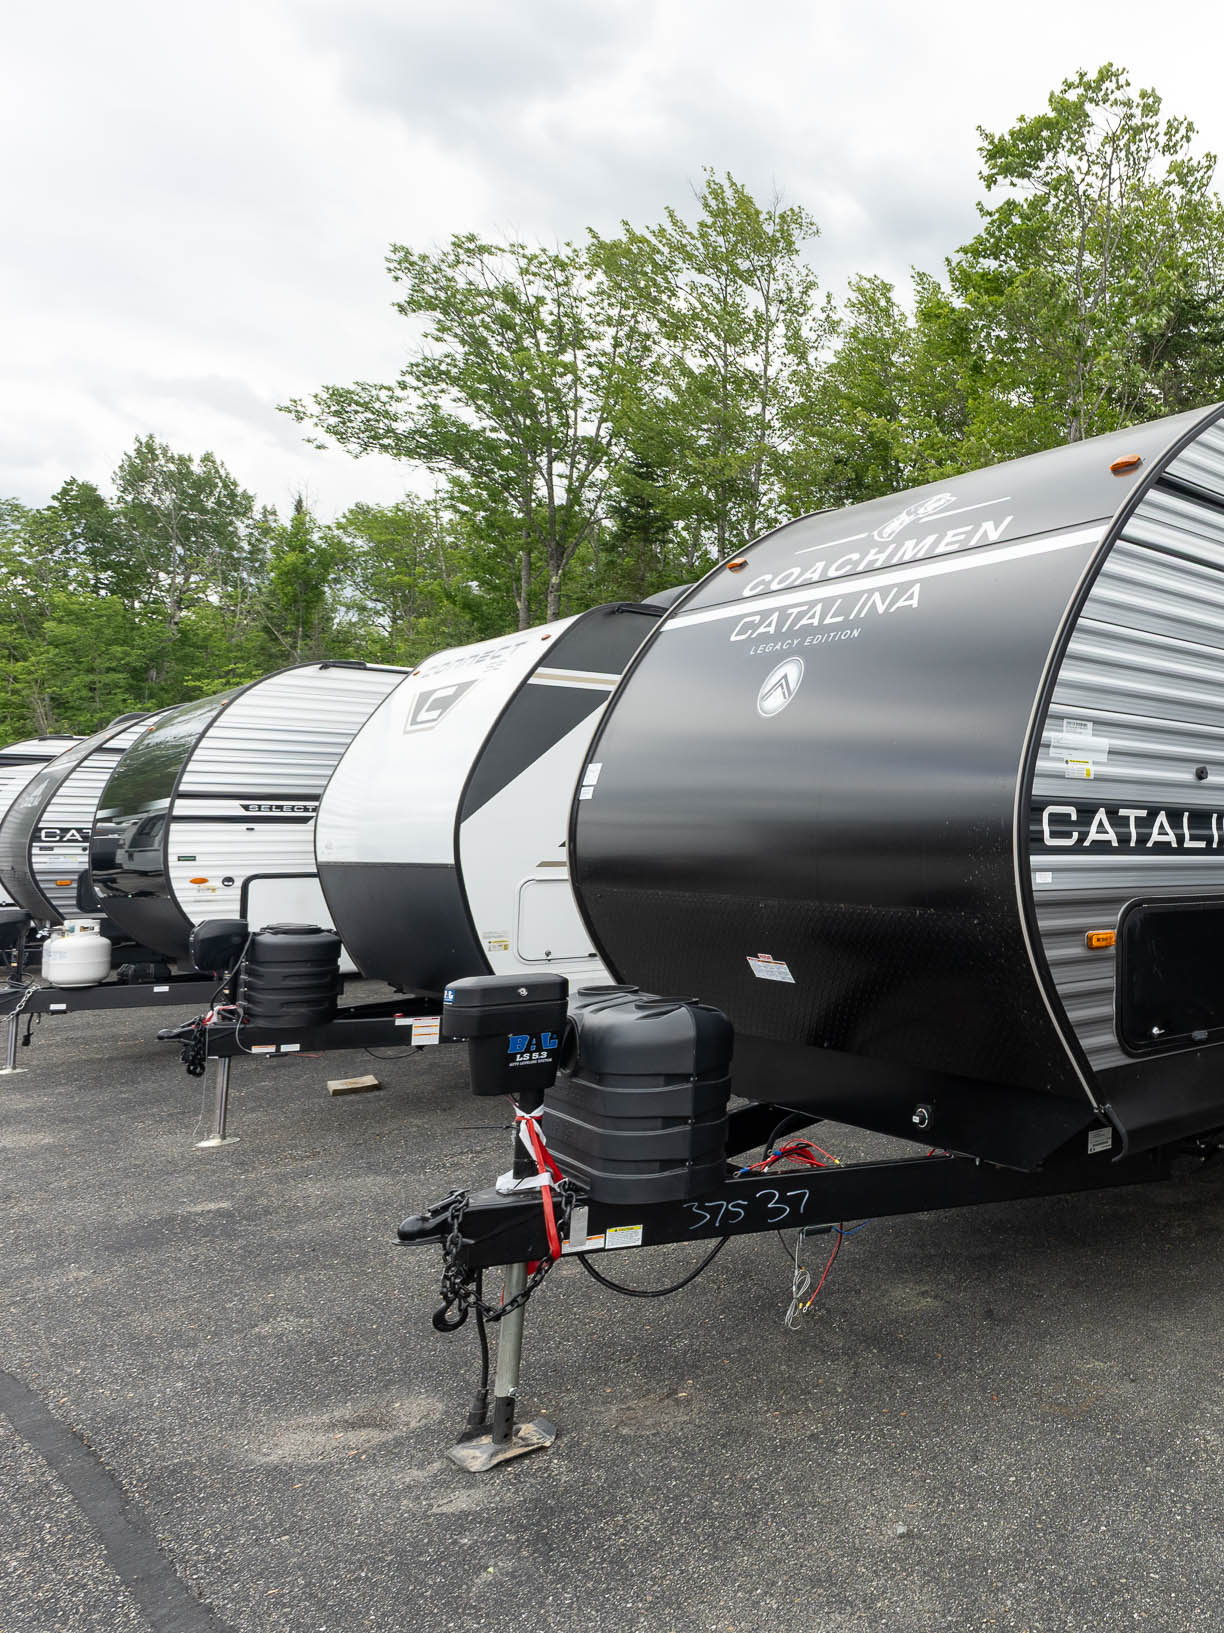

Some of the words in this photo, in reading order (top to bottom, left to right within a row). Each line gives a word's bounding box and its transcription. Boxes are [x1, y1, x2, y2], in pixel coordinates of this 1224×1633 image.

[742, 515, 1014, 598] COACHMEN
[729, 582, 922, 643] CATALINA
[749, 637, 800, 656] LEGACY
[804, 627, 862, 646] EDITION
[247, 804, 316, 813] SELECT
[515, 1053, 531, 1062] LS
[531, 1051, 548, 1060] 5.3
